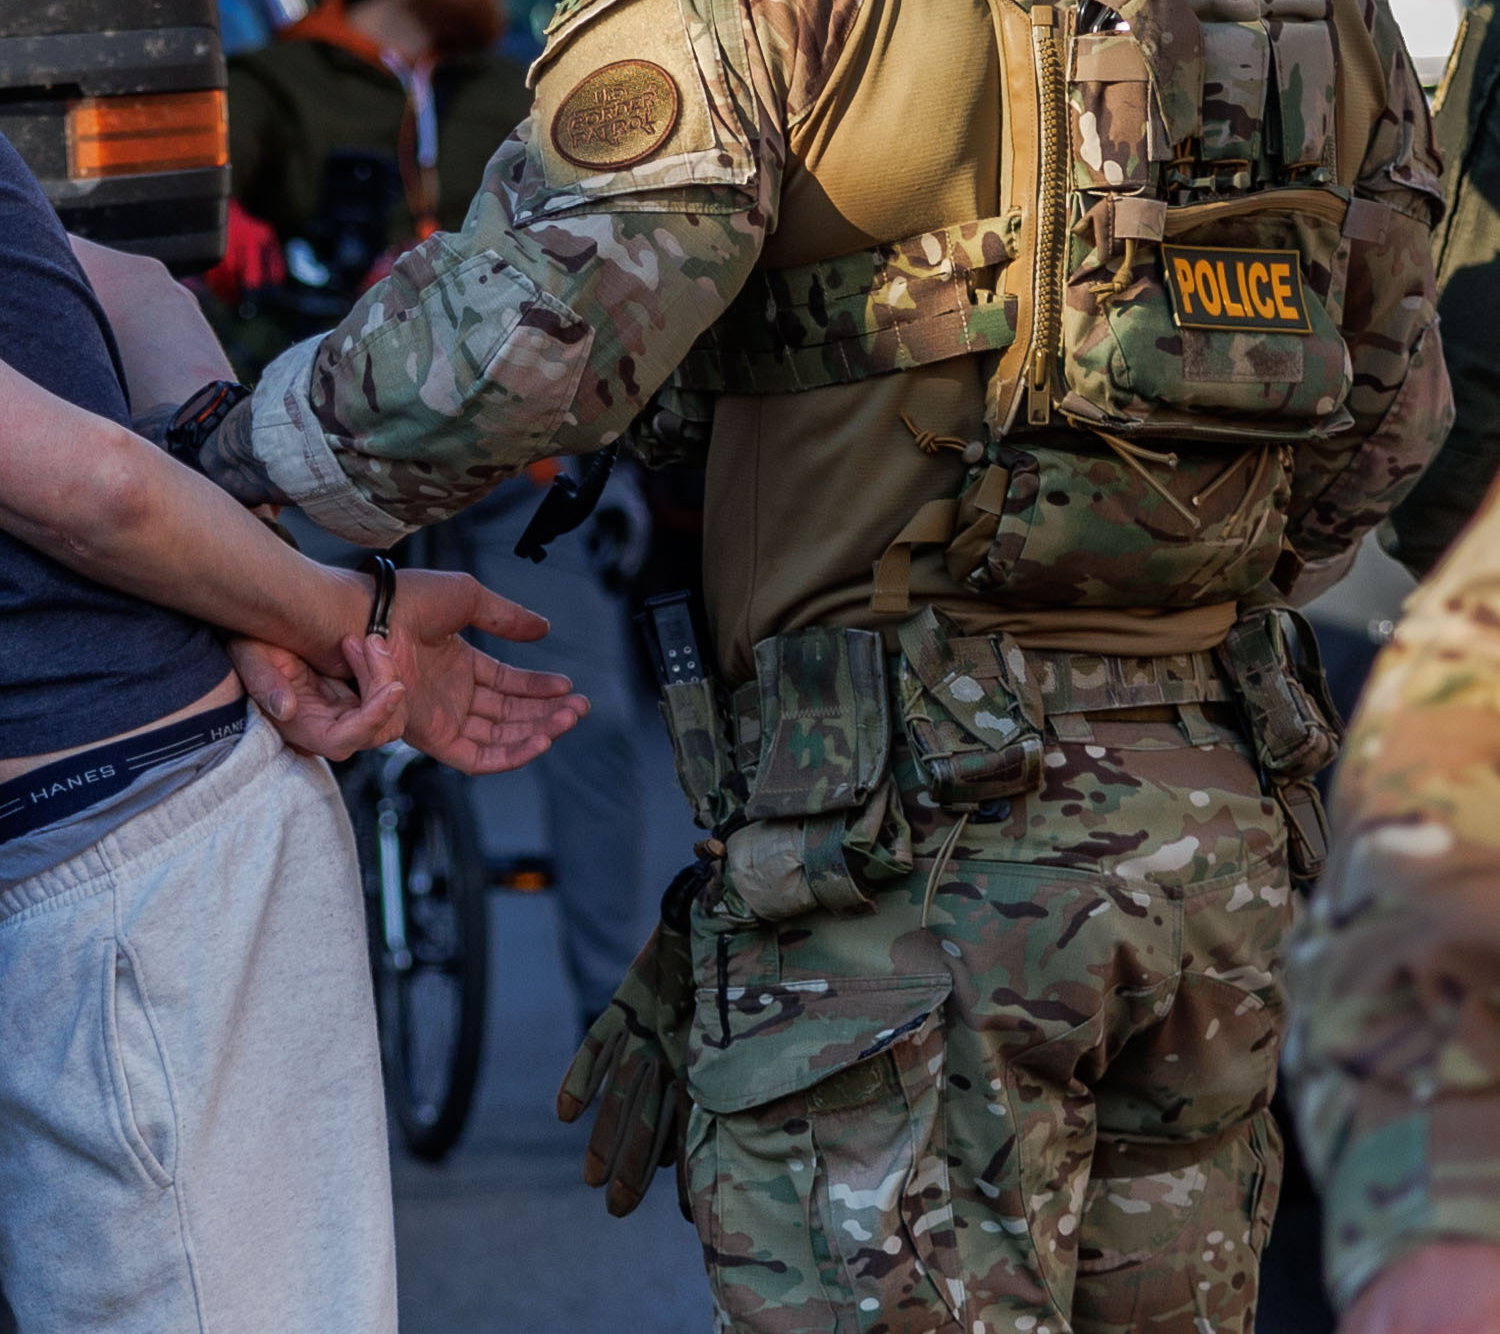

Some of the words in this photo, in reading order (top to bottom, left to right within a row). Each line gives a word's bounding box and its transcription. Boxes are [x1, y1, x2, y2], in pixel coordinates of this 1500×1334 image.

[1173, 257, 1300, 320] POLICE
[210, 717, 248, 742] HANE
[30, 764, 116, 804] HANES
